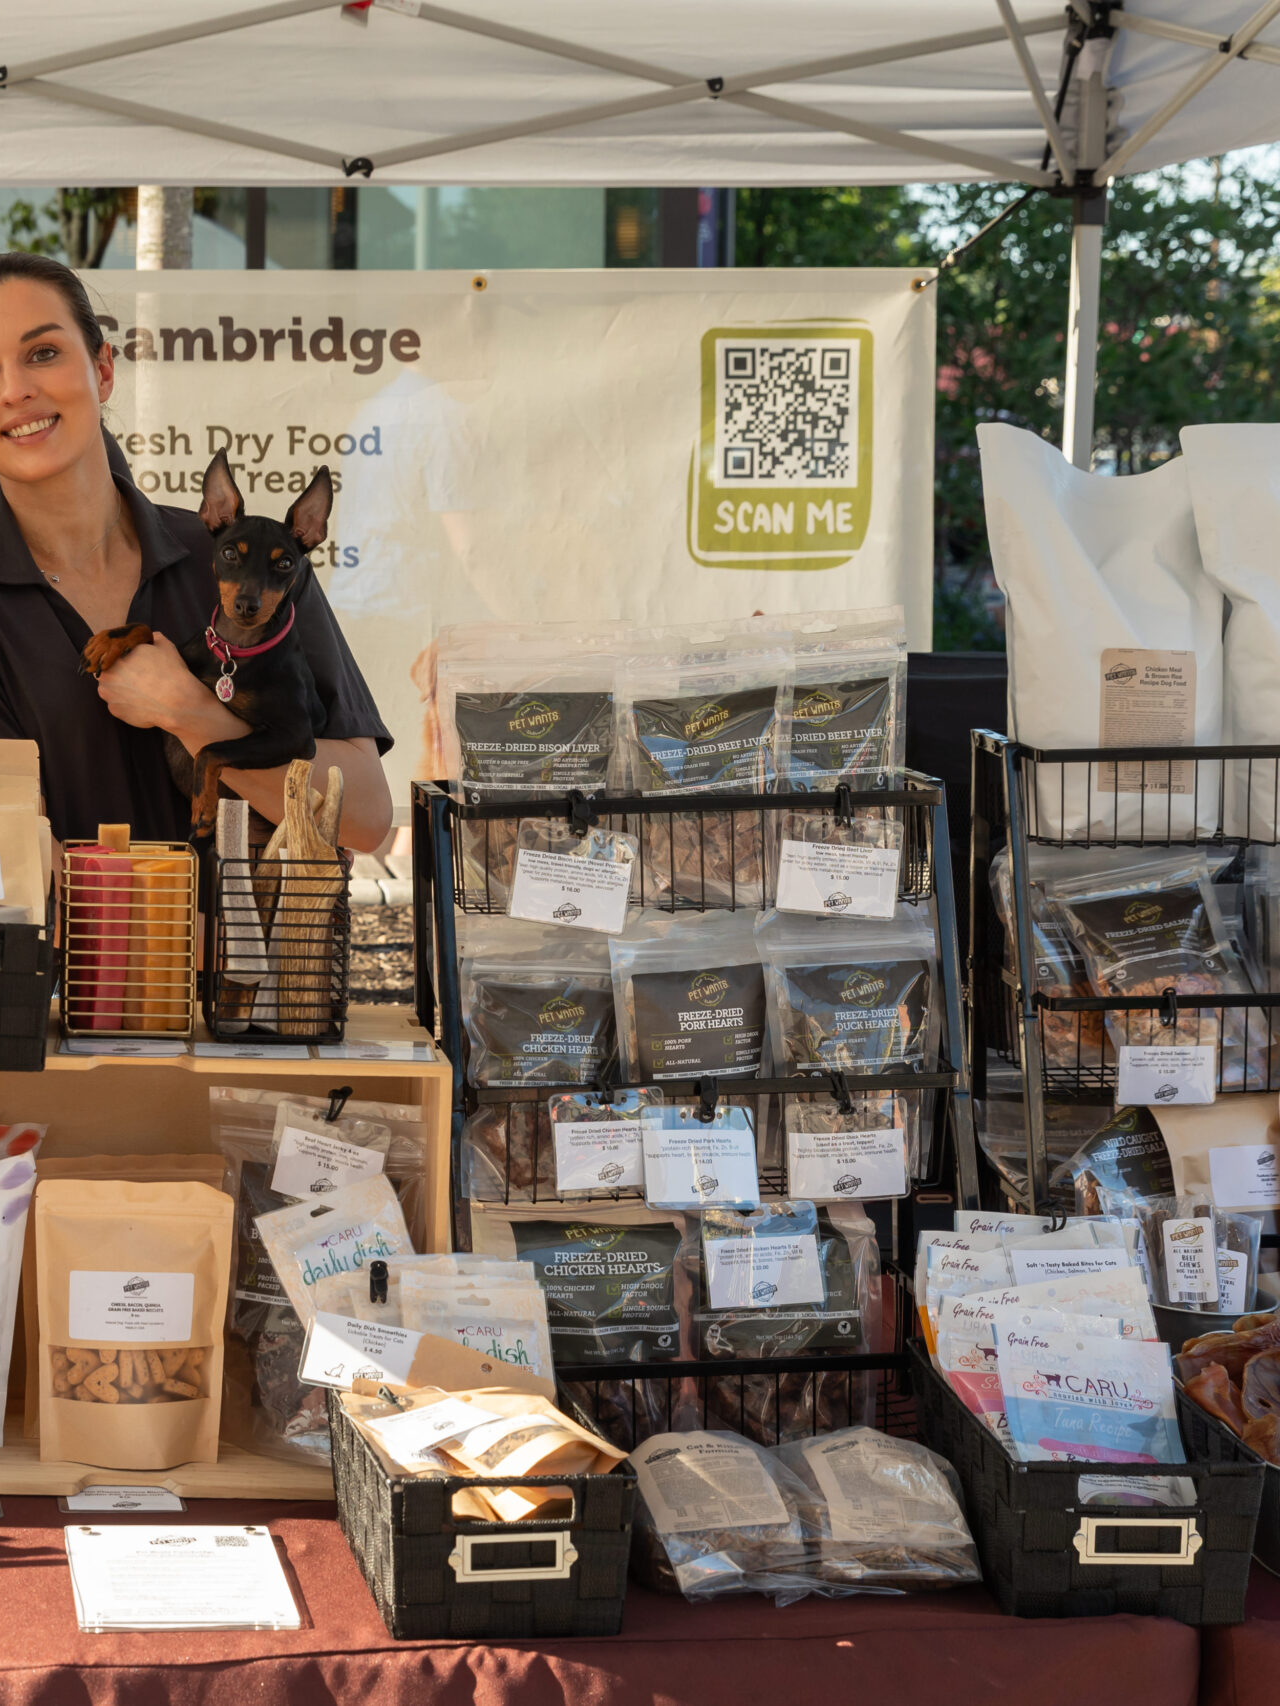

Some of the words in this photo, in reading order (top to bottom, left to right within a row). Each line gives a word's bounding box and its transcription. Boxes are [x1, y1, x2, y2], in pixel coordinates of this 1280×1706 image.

[205, 425, 274, 463] Dry
[286, 425, 383, 456] Food
[714, 500, 794, 535] SCAN
[806, 499, 853, 535] ME
[509, 719, 526, 731] PET
[528, 711, 560, 727] WANTS
[828, 730, 853, 740] BEEF
[853, 728, 883, 738] LIVER
[466, 742, 537, 752] FREEZE-DRIED
[538, 743, 570, 752] BISON
[572, 743, 600, 752] LIVER
[650, 742, 716, 760] FREEZE-DRIED
[718, 740, 742, 752] BEEF
[688, 989, 703, 1001] PET
[703, 979, 729, 996] WANTS
[841, 990, 857, 1002] PET
[857, 979, 885, 996] WANTS
[539, 1011, 555, 1024] PET
[556, 1006, 585, 1020] WANTS
[678, 1007, 744, 1022] FREEZE-DRIED
[835, 1008, 899, 1021] FREEZE-DRIED
[680, 1020, 707, 1032] PORK
[708, 1017, 744, 1029] HEARTS
[836, 1021, 864, 1031] DUCK
[865, 1018, 900, 1029] HEARTS
[530, 1033, 595, 1044] FREEZE-DRIED
[522, 1044, 567, 1053] CHICKEN
[568, 1045, 599, 1055] HEARTS
[665, 1058, 701, 1066] ALL-NATURAL
[1126, 1131, 1159, 1145] CAUGHT
[969, 1219, 994, 1234] Grain
[994, 1220, 1015, 1234] Free
[327, 1225, 363, 1246] CARU
[352, 1231, 397, 1268] dish
[554, 1251, 648, 1263] FREEZE-DRIED
[544, 1264, 605, 1276] CHICKEN
[608, 1262, 661, 1275] HEARTS
[941, 1254, 961, 1271] Grain
[961, 1258, 980, 1273] Free
[563, 1284, 596, 1292] CHICKEN
[640, 1282, 664, 1290] DROOL
[1001, 1292, 1020, 1305] Free
[952, 1303, 974, 1320] Grain
[974, 1306, 995, 1321] Free
[347, 1321, 363, 1330] Daily
[363, 1323, 377, 1332] Dish
[377, 1327, 408, 1338] Smoothies
[465, 1325, 503, 1337] CARU
[1007, 1331, 1029, 1347] Grain
[1030, 1335, 1050, 1349] Free
[485, 1338, 535, 1366] dish
[1065, 1375, 1129, 1400] CARU
[1088, 1396, 1107, 1406] with
[1054, 1407, 1085, 1432] Tuna
[1088, 1412, 1133, 1444] Recipe
